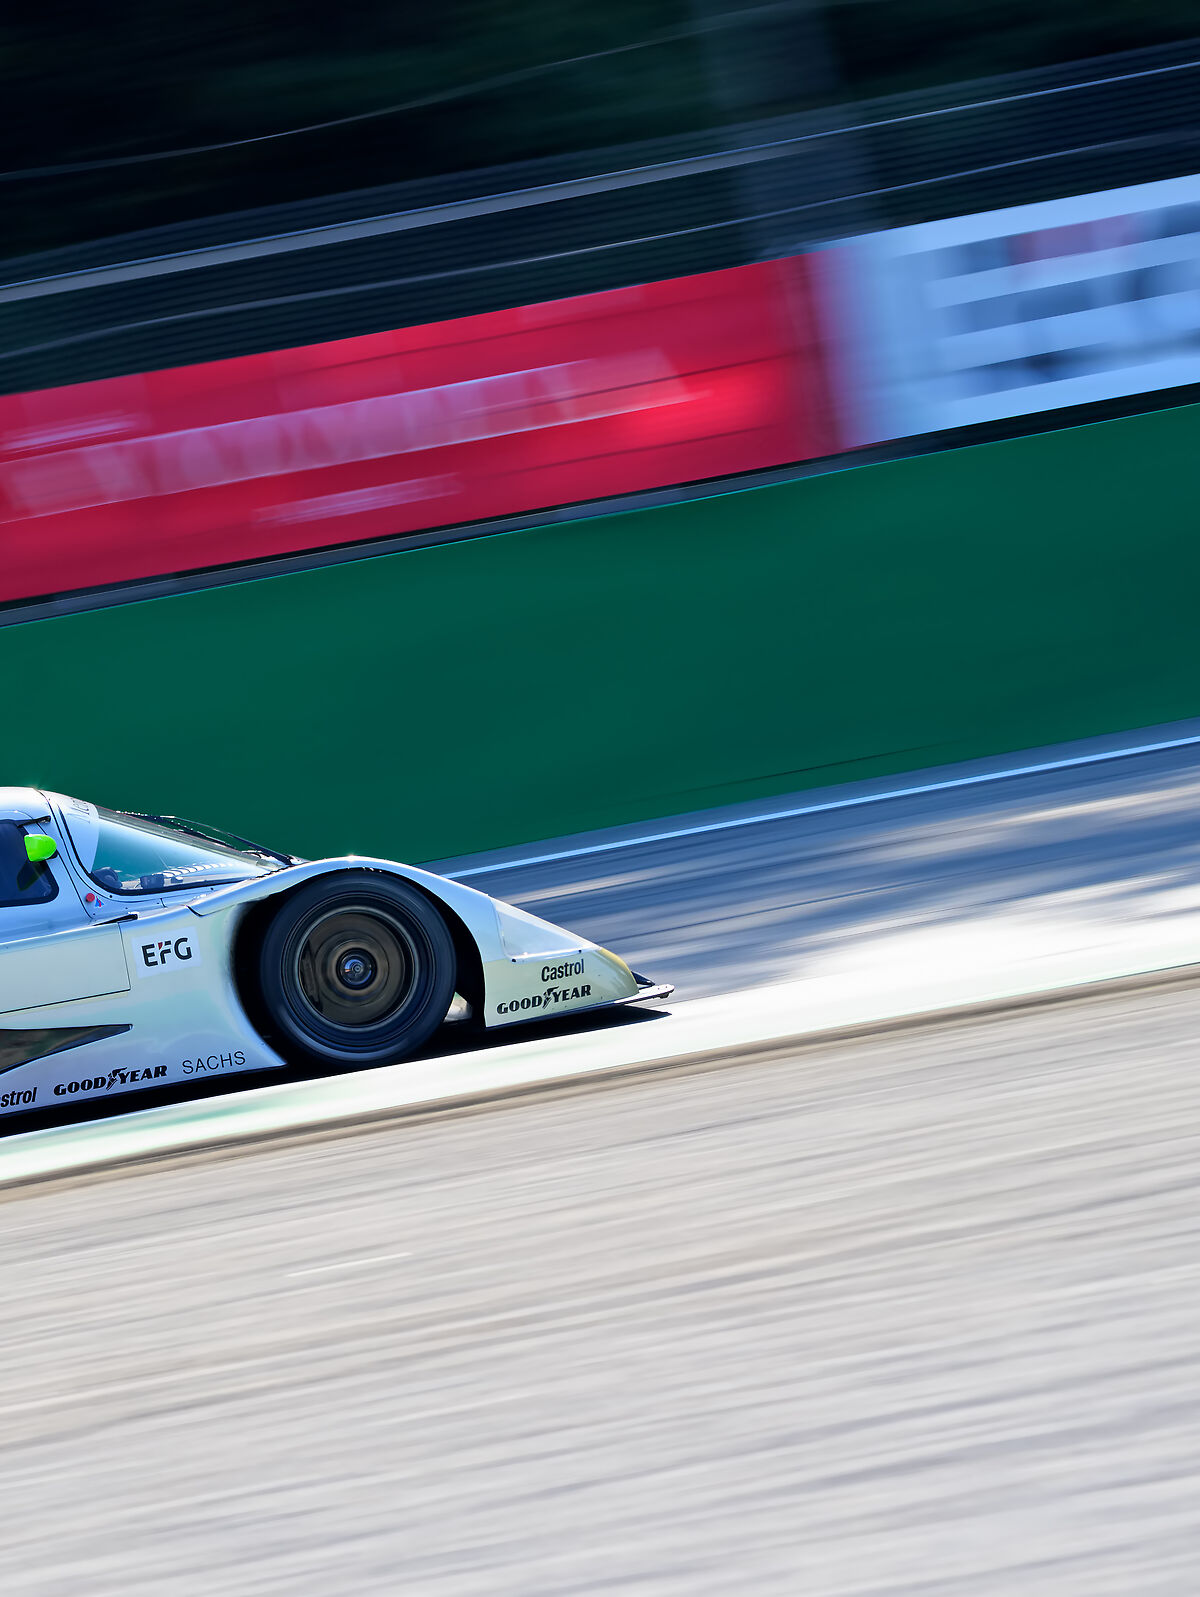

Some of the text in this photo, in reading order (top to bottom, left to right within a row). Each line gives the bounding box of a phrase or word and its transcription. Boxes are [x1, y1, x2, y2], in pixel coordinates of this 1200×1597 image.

[141, 937, 193, 967] EFG
[541, 959, 584, 982] Castrol
[182, 1051, 246, 1075] SACHS
